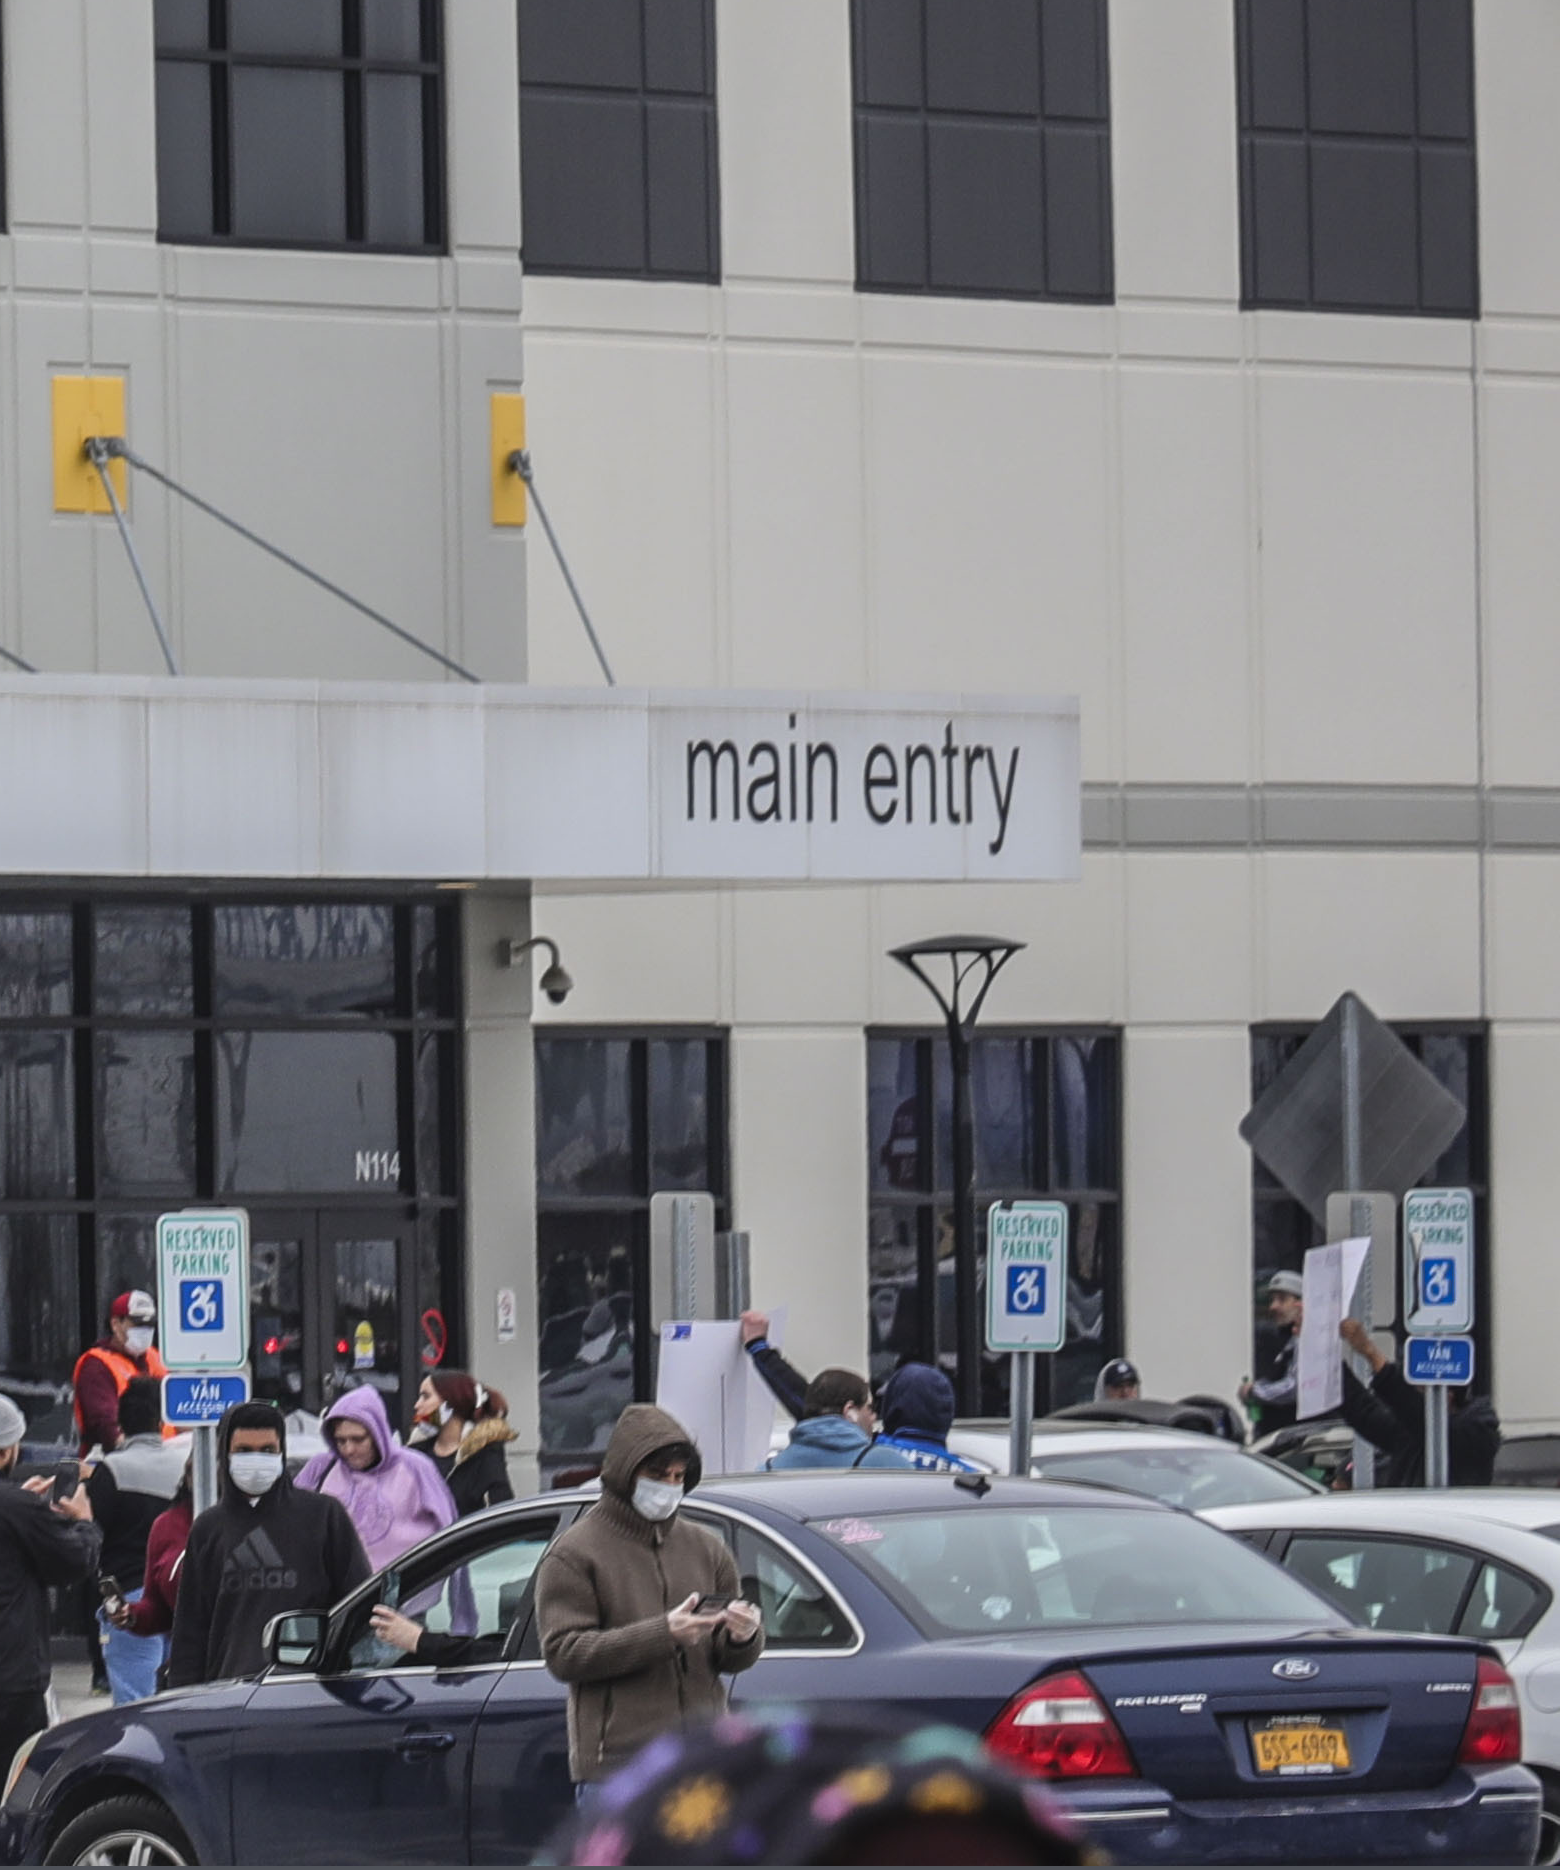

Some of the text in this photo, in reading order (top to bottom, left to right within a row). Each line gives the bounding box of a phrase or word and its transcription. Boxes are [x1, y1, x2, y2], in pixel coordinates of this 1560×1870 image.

[686, 711, 1020, 856] main entry
[355, 1150, 401, 1182] N114
[1408, 1202, 1468, 1221] RESERVED
[996, 1216, 1058, 1237] RESERVED
[166, 1227, 235, 1251] RESERVED
[1001, 1239, 1053, 1261] PARKING
[172, 1252, 229, 1275] PARKING
[1427, 1345, 1450, 1361] VAN
[191, 1383, 220, 1400] VAN
